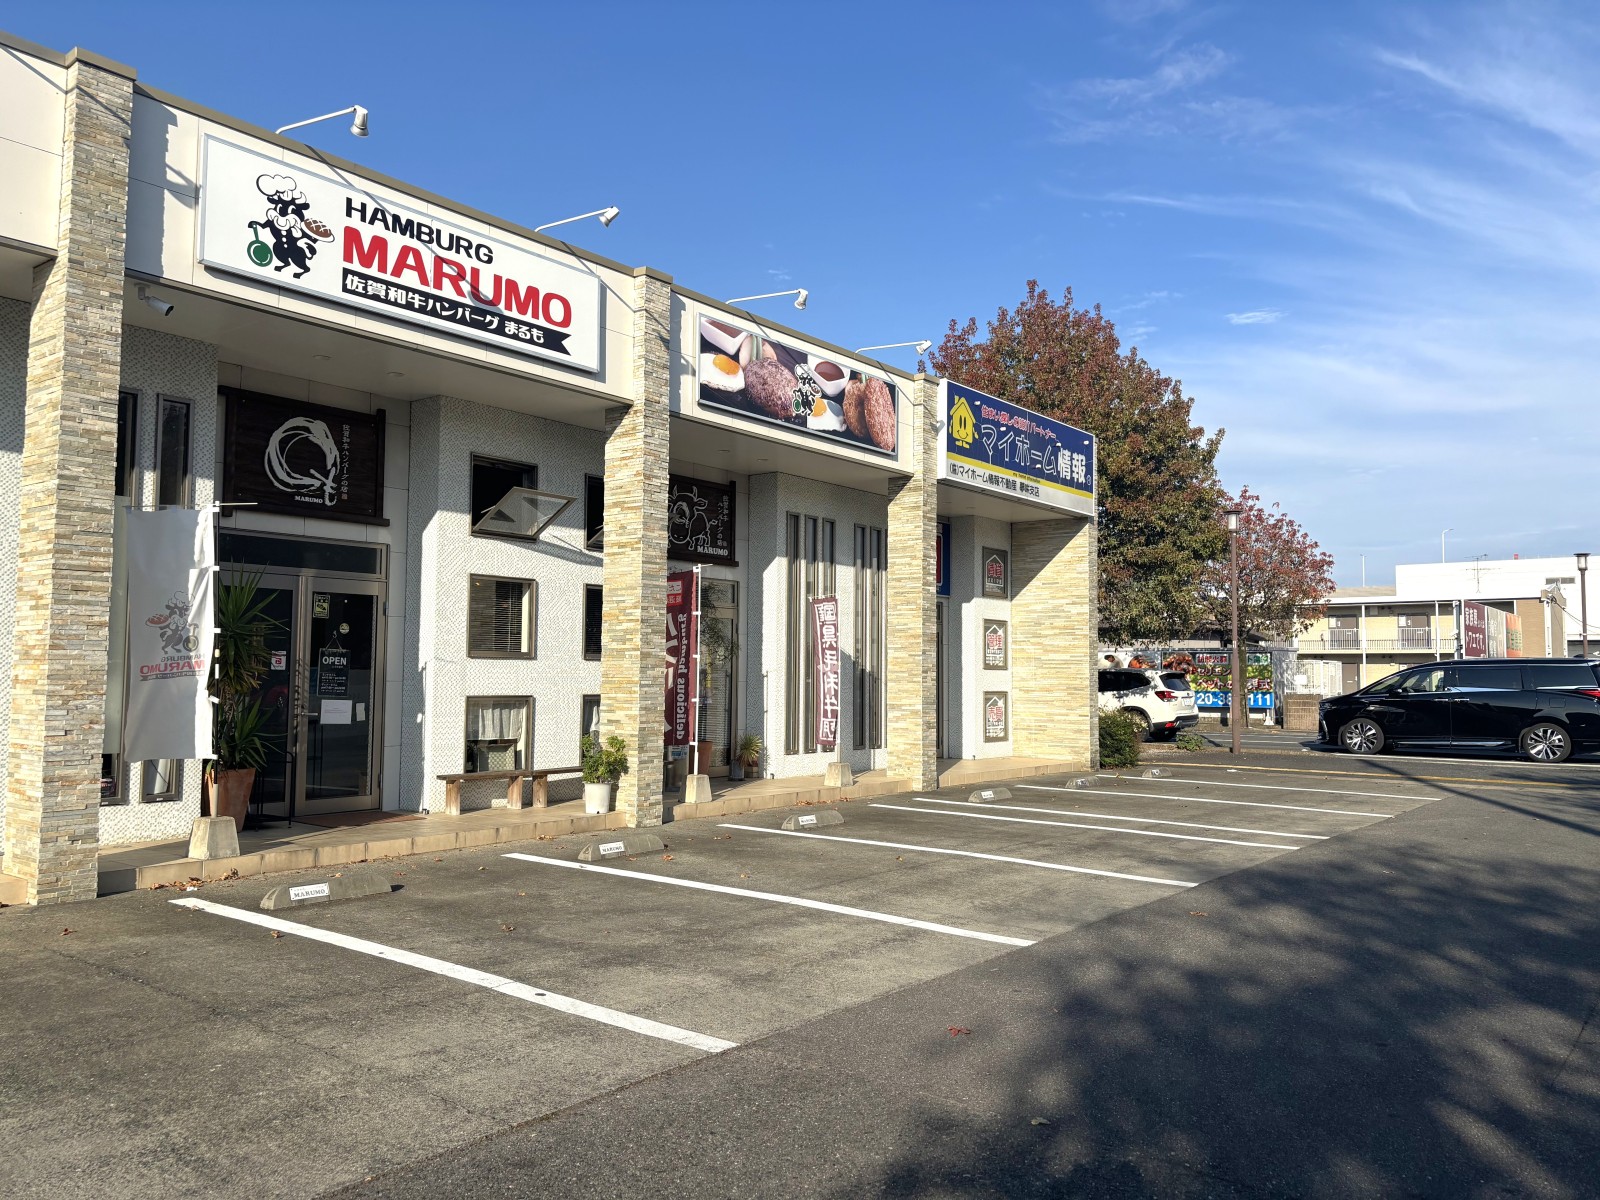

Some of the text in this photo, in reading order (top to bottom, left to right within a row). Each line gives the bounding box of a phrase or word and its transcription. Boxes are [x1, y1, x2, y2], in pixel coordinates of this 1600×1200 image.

[346, 196, 494, 265] HAMBURG
[343, 225, 572, 329] MARUMO
[345, 273, 545, 344] 佐賀和牛ハンバーグ まるも
[981, 424, 1086, 484] マイホーム情報
[294, 495, 324, 504] MARUMO
[696, 545, 729, 556] MARUMO
[322, 656, 347, 666] OPEN
[602, 845, 623, 853] MARUMO
[293, 888, 326, 899] MARUMO
